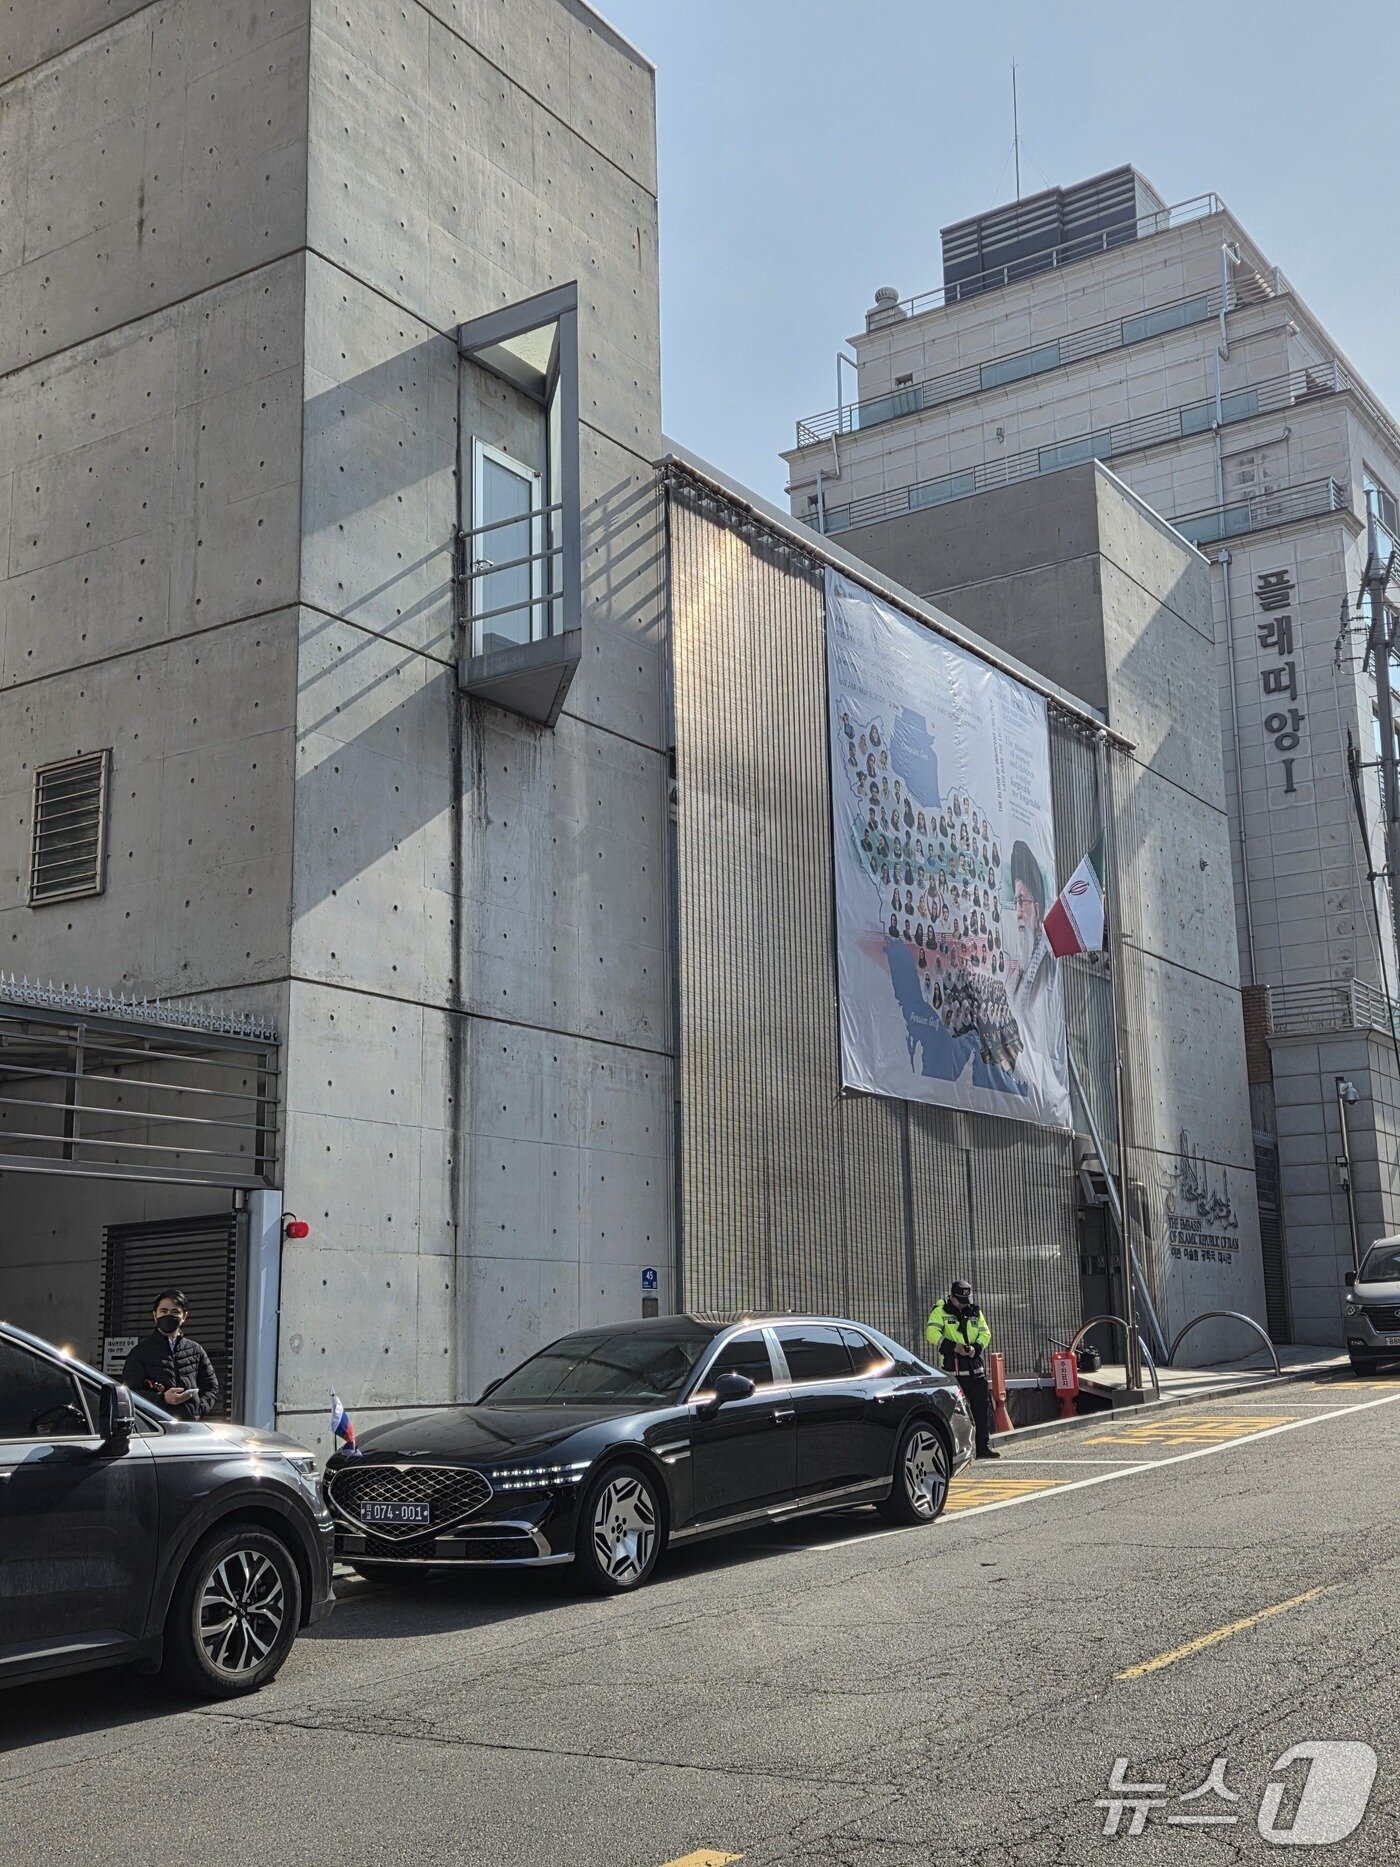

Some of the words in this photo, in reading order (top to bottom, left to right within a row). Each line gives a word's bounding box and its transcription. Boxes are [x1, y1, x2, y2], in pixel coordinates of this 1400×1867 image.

[1180, 1219, 1202, 1232] EMBASSY
[1178, 1232, 1198, 1245] ISLAMIC
[1199, 1235, 1221, 1248] REPUBLIC
[1228, 1238, 1239, 1249] IRAN
[1171, 1247, 1181, 1259] 이란
[1184, 1248, 1199, 1260] 이슬람
[1201, 1250, 1216, 1263] 공화국
[1218, 1252, 1232, 1264] 대사관
[646, 1271, 653, 1280] 45
[1060, 1361, 1069, 1387] 주차금지
[374, 1505, 423, 1520] 074-001
